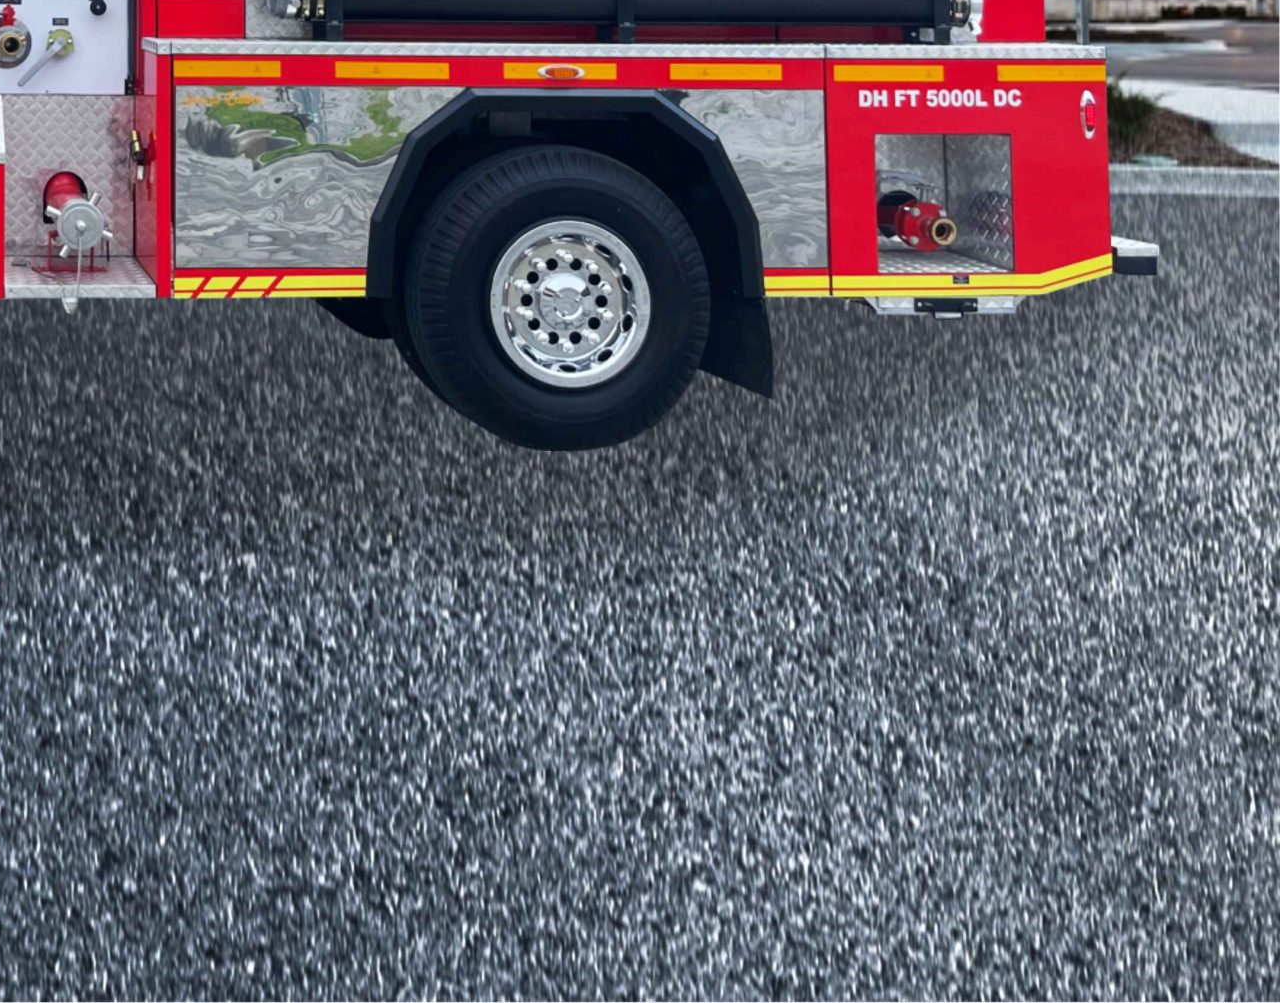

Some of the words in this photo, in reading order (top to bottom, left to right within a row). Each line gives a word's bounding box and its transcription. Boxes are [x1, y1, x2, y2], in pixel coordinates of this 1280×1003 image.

[858, 89, 888, 108] DH
[894, 89, 920, 108] FT
[926, 89, 988, 108] 5000L
[993, 89, 1022, 108] DC
